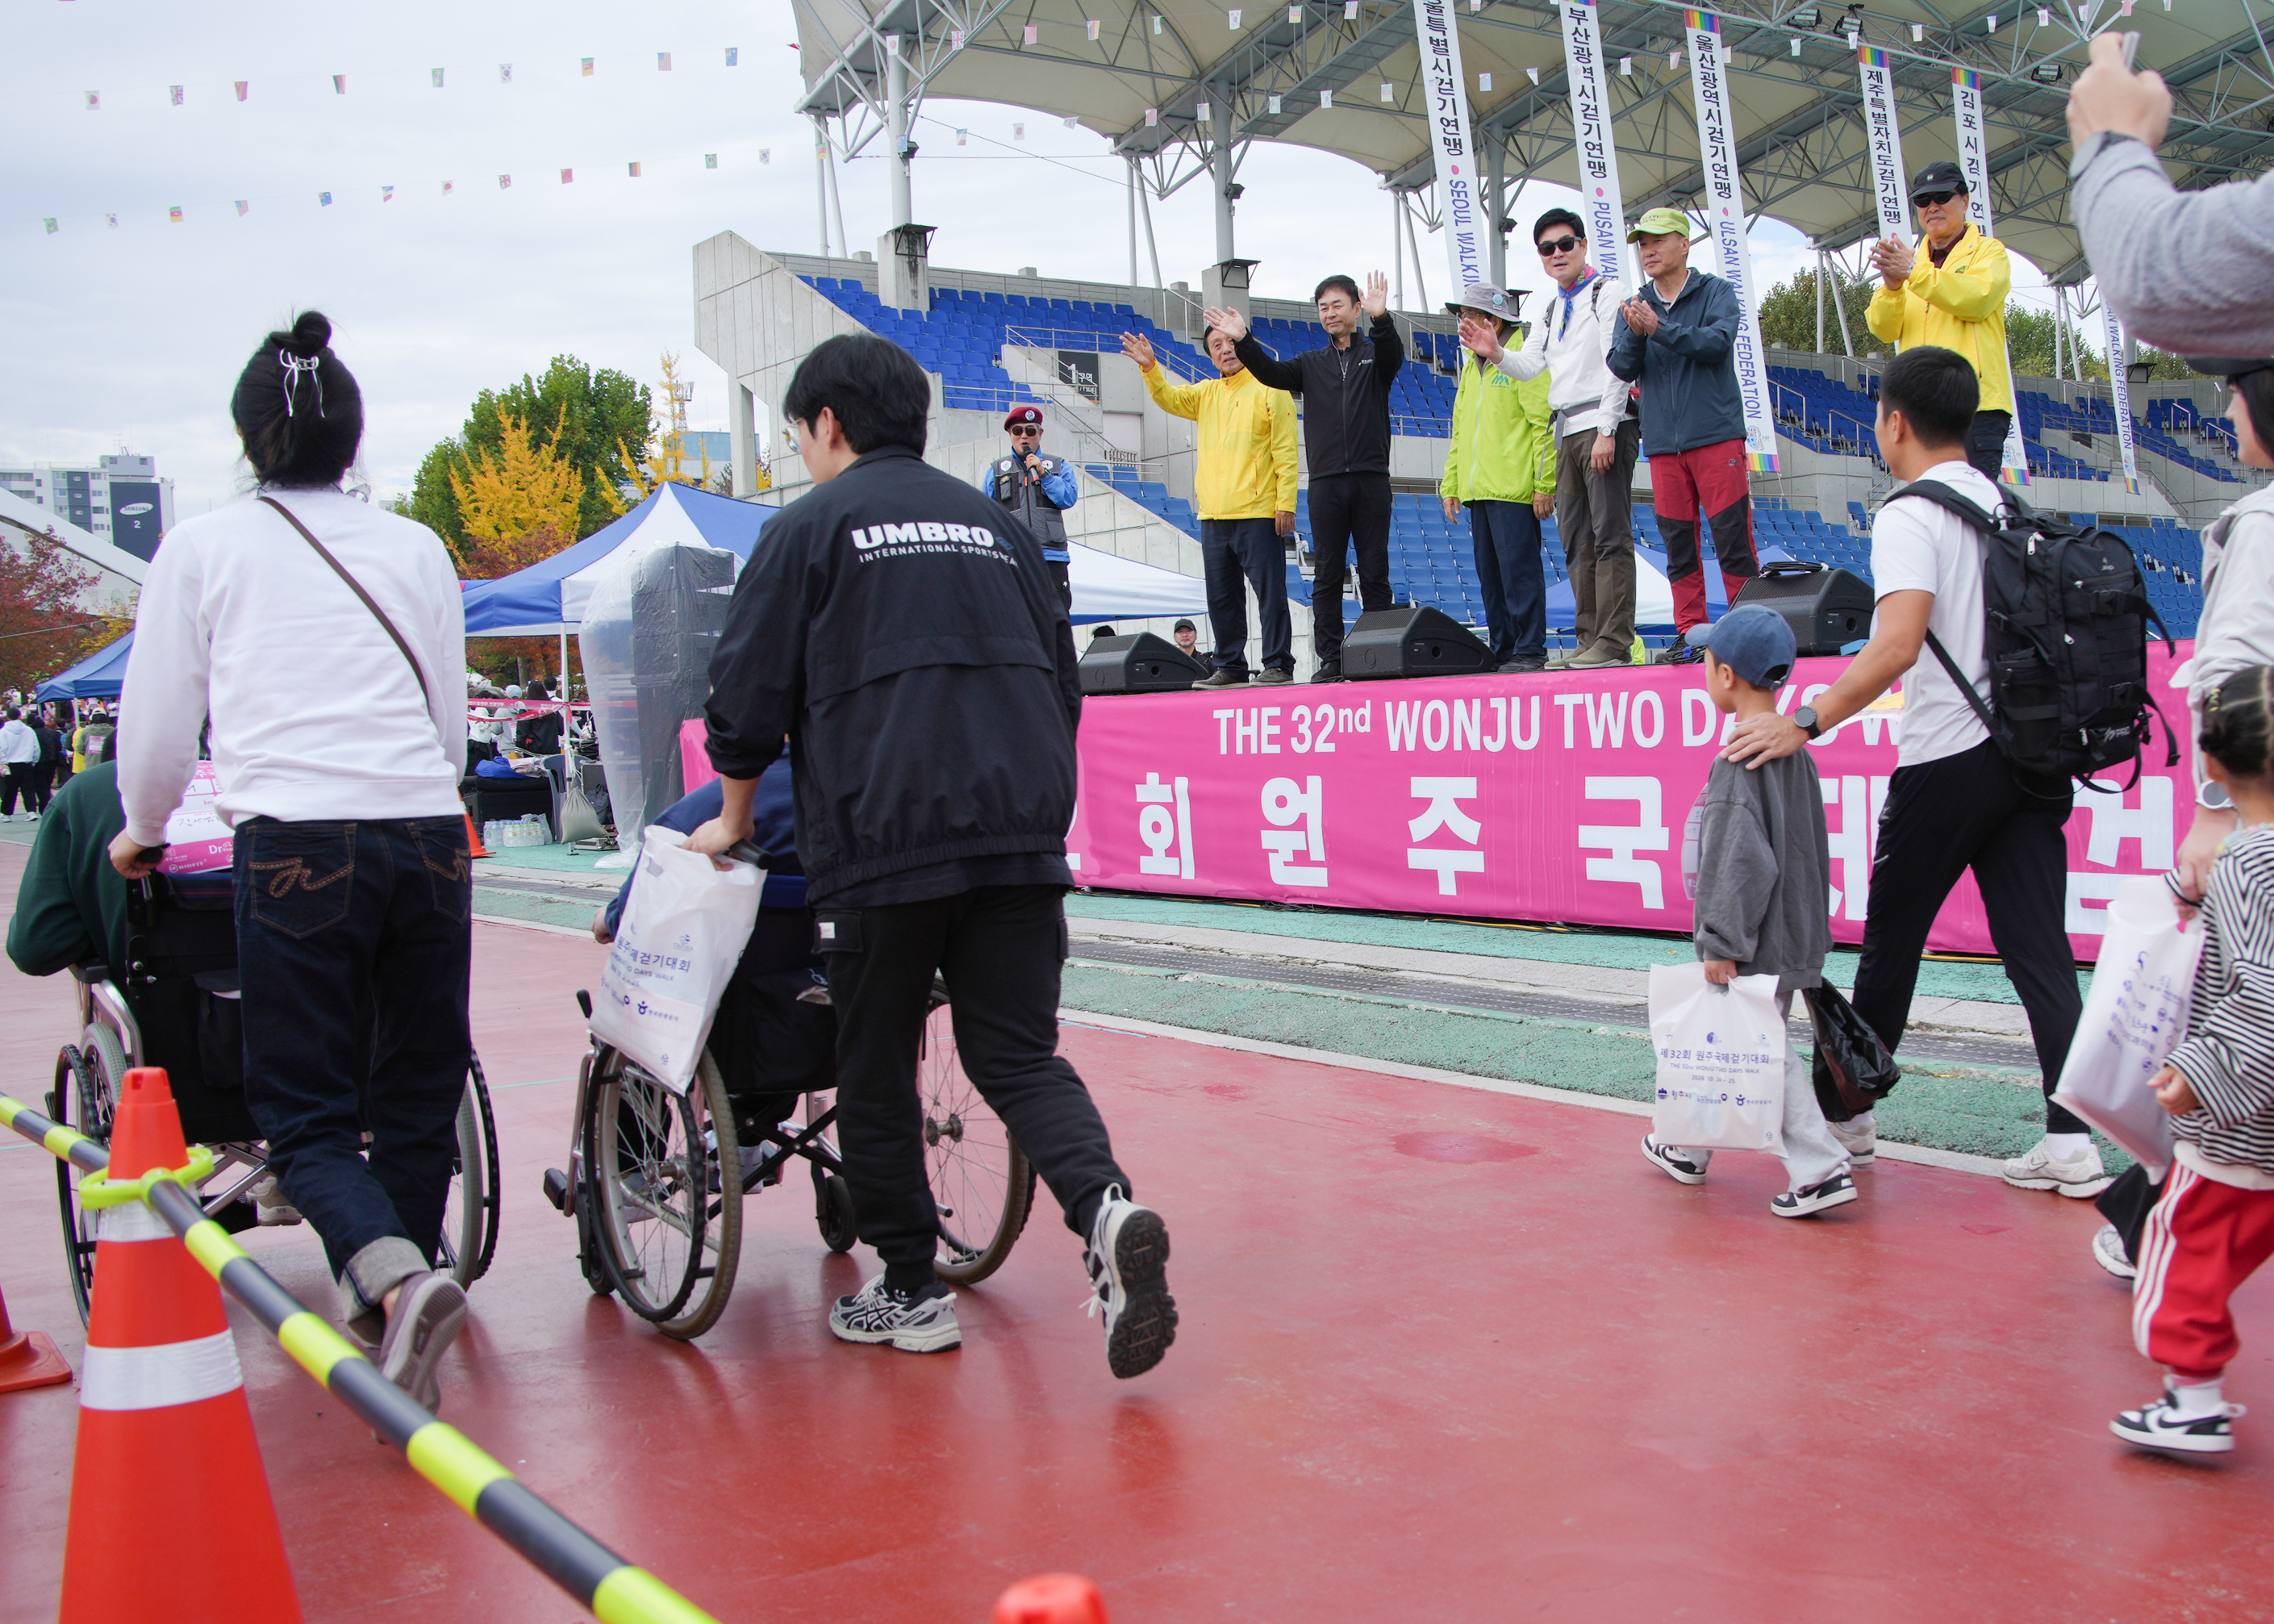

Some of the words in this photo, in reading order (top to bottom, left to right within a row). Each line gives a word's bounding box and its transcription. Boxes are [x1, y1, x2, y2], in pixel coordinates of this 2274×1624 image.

[1695, 35, 1732, 199] 울산광역시걷기연맹
[1867, 69, 1901, 224] 제주특별자치도걷기연맹
[1449, 179, 1472, 227] SEOUL
[1592, 201, 1616, 249] PUSAN
[1456, 232, 1480, 289] WALKIN
[1720, 221, 1739, 265] ULSAN
[1736, 335, 1763, 420] FEDERATION
[2109, 325, 2124, 377] WALKING
[2116, 378, 2132, 449] FEDERATION
[133, 520, 141, 528] 2
[851, 522, 995, 549] UMBRO
[859, 544, 959, 563] INTERNATIONAL
[1212, 706, 1281, 755] THE
[1290, 700, 1371, 754] 32nd
[1385, 695, 1541, 753] WONJU
[1554, 691, 1665, 749] TWO
[178, 861, 204, 870] BIOFIT
[634, 968, 653, 977] DAYS
[655, 971, 675, 981] WALK
[1659, 1048, 1692, 1060] 제32회
[1696, 1050, 1770, 1064] 원주국제걷기대회
[1671, 1090, 1692, 1100] 원주시
